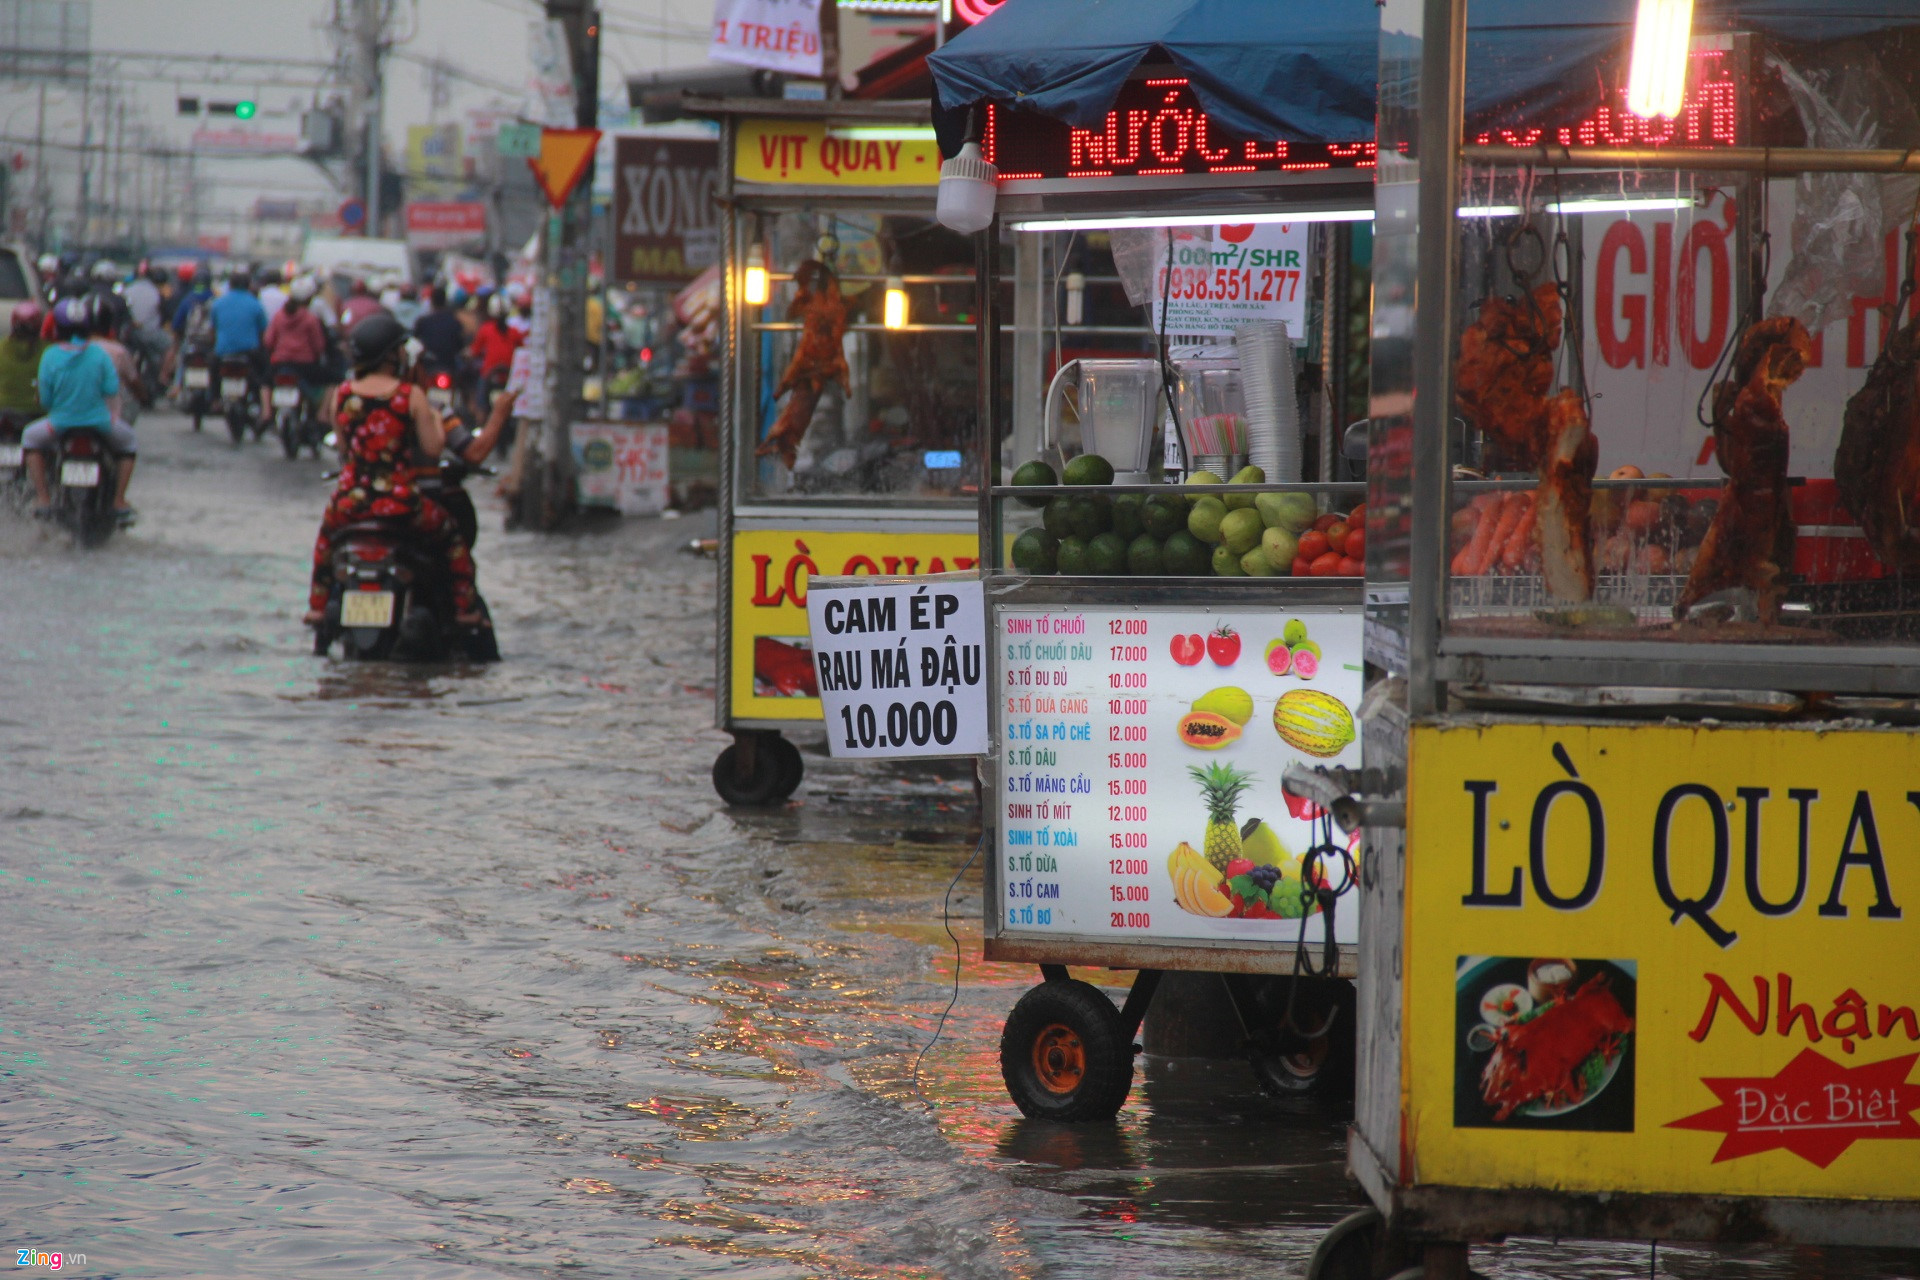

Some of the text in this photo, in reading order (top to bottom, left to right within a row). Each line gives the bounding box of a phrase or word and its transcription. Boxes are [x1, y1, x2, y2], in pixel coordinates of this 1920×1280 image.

[716, 20, 818, 59] 1 TRIỆU
[758, 134, 808, 178] VỊT
[819, 139, 903, 178] QUAY
[1158, 267, 1300, 302] 0938.551.277
[750, 539, 820, 609] LÒ
[824, 585, 960, 635] CAM ÉP
[1007, 613, 1148, 635] SINH TỐ CHUỐI 12.000
[1007, 639, 1148, 662] S.TỐ CHUỐI DÂU 17.000
[818, 634, 981, 695] RAU MÁ ĐẬU
[1007, 664, 1147, 688] S.TỐ ĐU ĐỦ 10.000
[1007, 692, 1147, 715] S.TỐ DƯA GANG 10.000
[841, 699, 958, 749] 10.000
[1008, 718, 1147, 742] S.TỐ SA PÔ CHÊ 12.000
[1008, 745, 1147, 768] S.TỐ DÂU 15.000
[1008, 772, 1032, 793] S.TỐ
[1070, 772, 1091, 794] CẦU
[1107, 779, 1147, 796] 15.000
[1008, 798, 1147, 822] SINH TỐ MÍT 12.000
[1008, 825, 1148, 849] SINH TỐ XOÀI 15.000
[1461, 741, 1920, 949] LÒ QUA
[1008, 851, 1148, 875] S.TỐ DỪA 12.000
[1009, 877, 1149, 902] S.TỐ CAM 15.000
[1009, 903, 1150, 929] S.TỐ BƠ 20.000
[1687, 971, 1920, 1055] Nhận
[1734, 1082, 1900, 1133] Đặc Biệt
